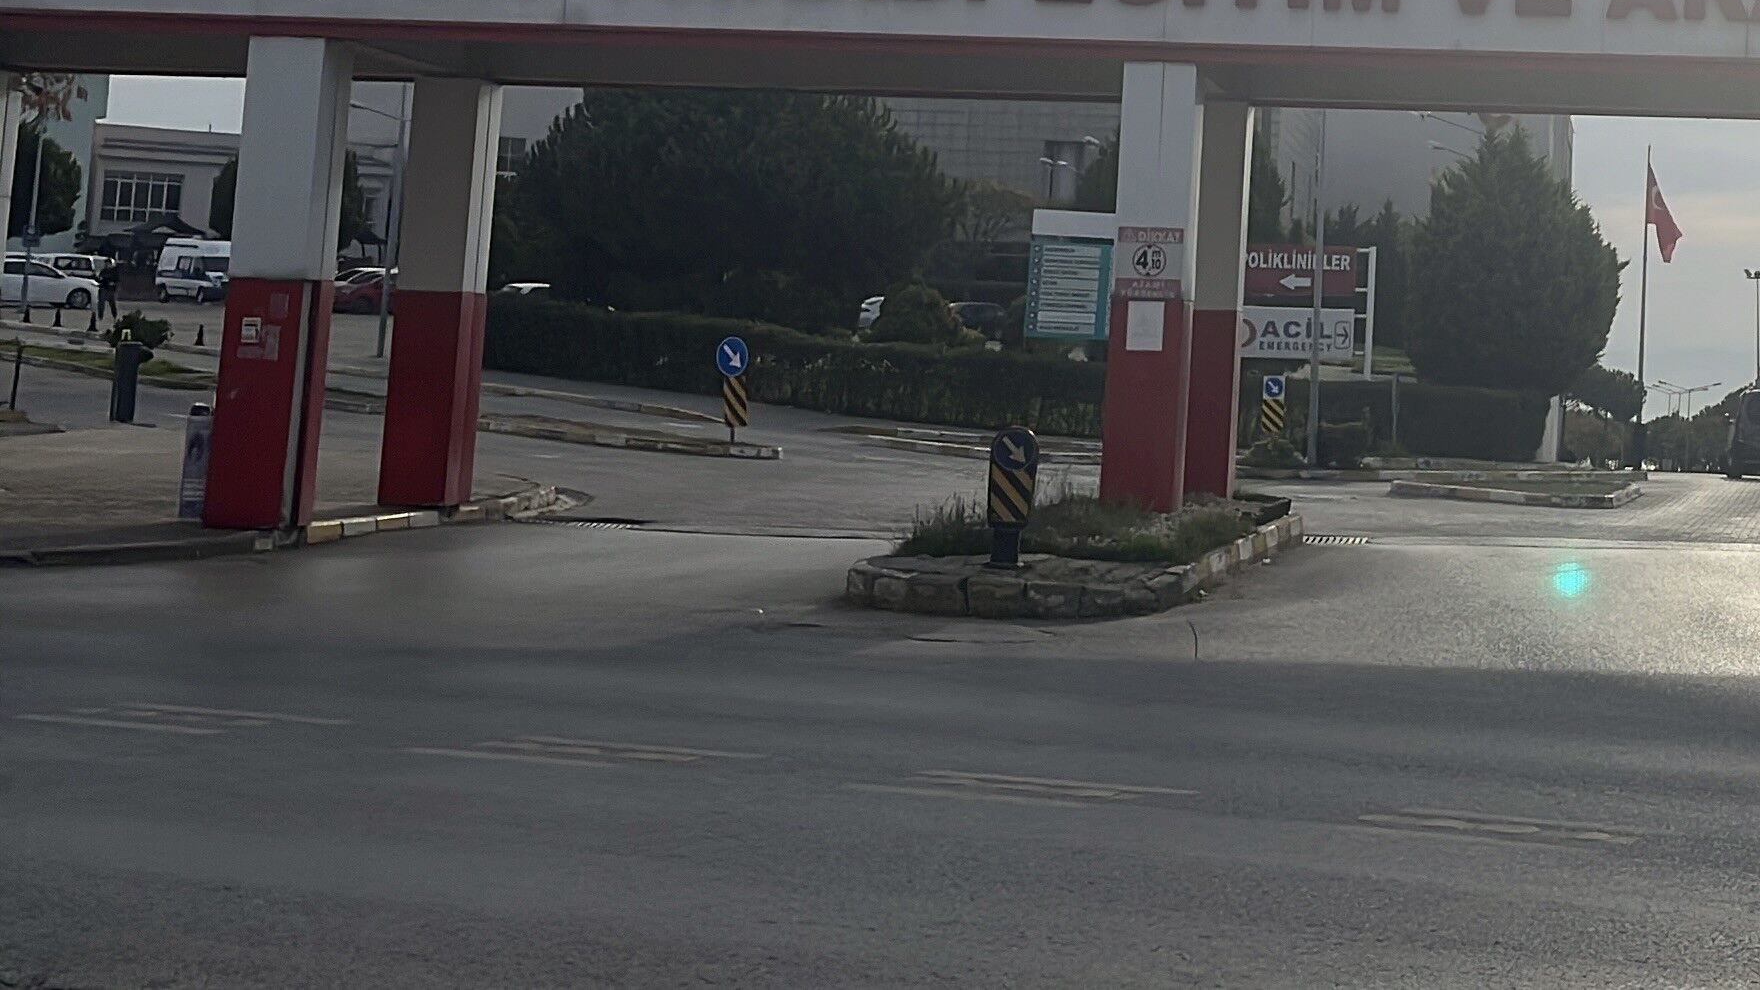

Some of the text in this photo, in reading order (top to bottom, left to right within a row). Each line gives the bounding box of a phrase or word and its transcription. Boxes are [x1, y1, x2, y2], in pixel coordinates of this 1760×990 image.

[1136, 250, 1149, 269] 4
[1152, 259, 1161, 269] 10
[1246, 249, 1352, 271] OLİKLİNİLER
[1260, 317, 1333, 339] ACİL
